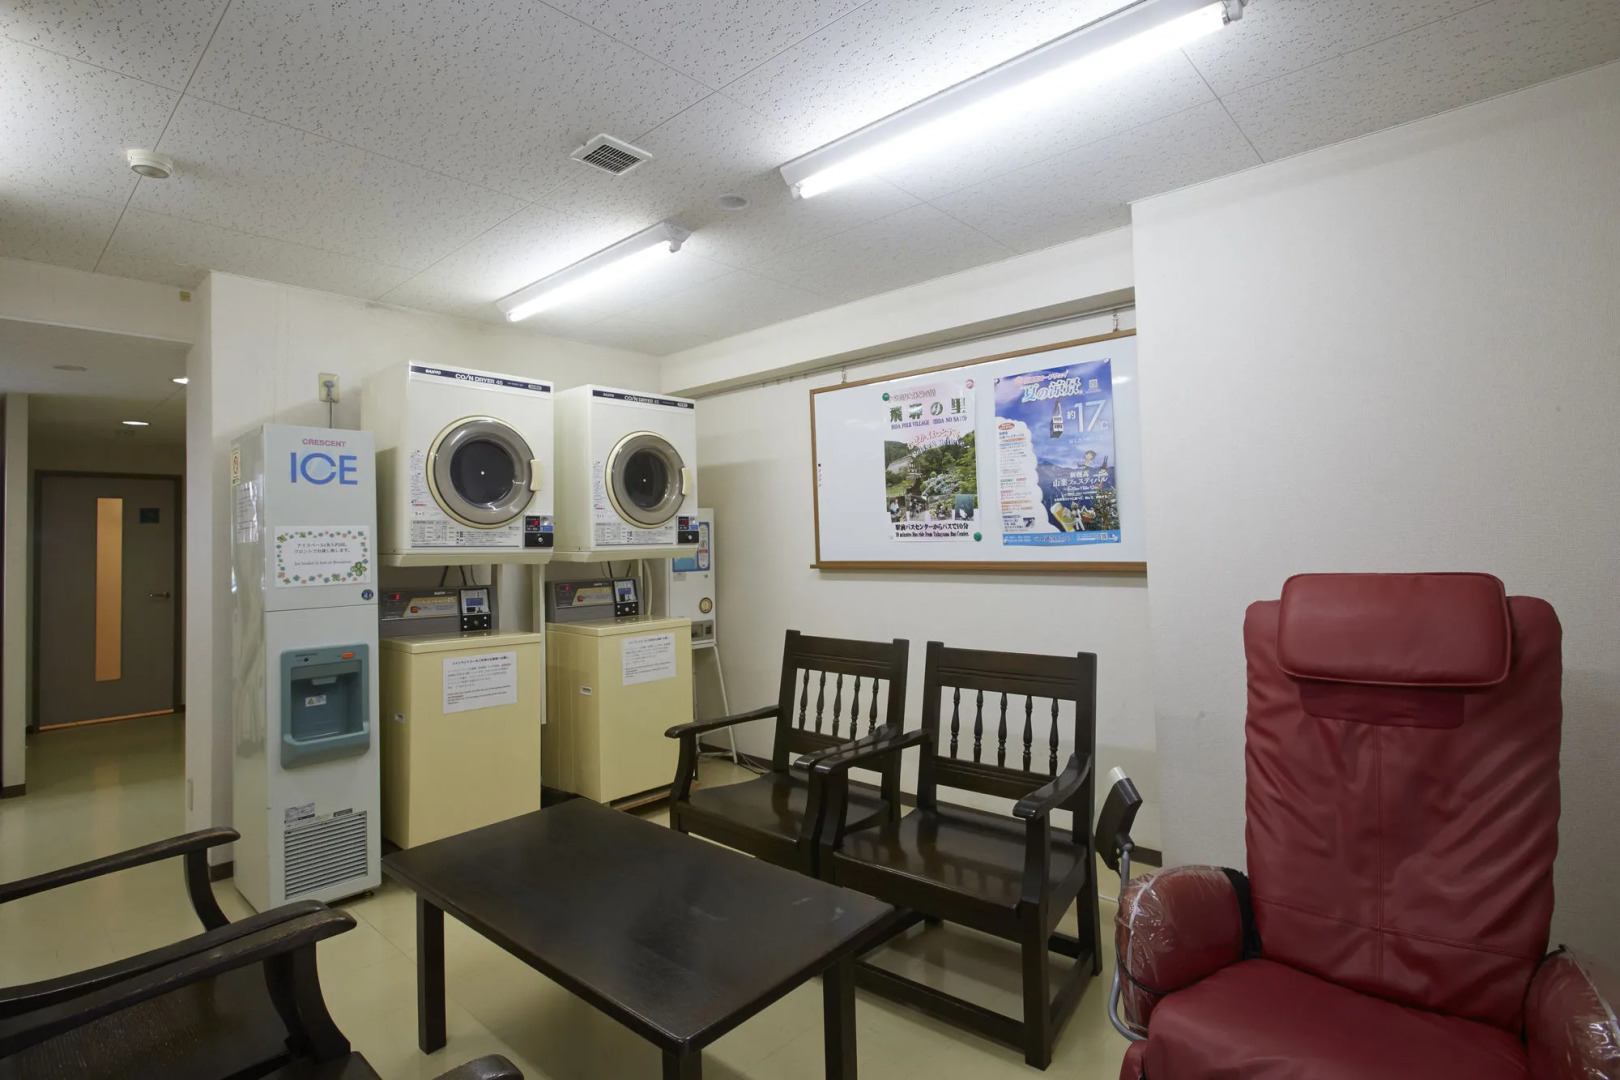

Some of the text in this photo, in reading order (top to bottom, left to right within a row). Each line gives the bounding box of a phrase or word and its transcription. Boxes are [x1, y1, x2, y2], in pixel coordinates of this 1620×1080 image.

[475, 376, 495, 385] DRYER
[302, 438, 346, 448] CRESCENT
[290, 452, 358, 485] ICE
